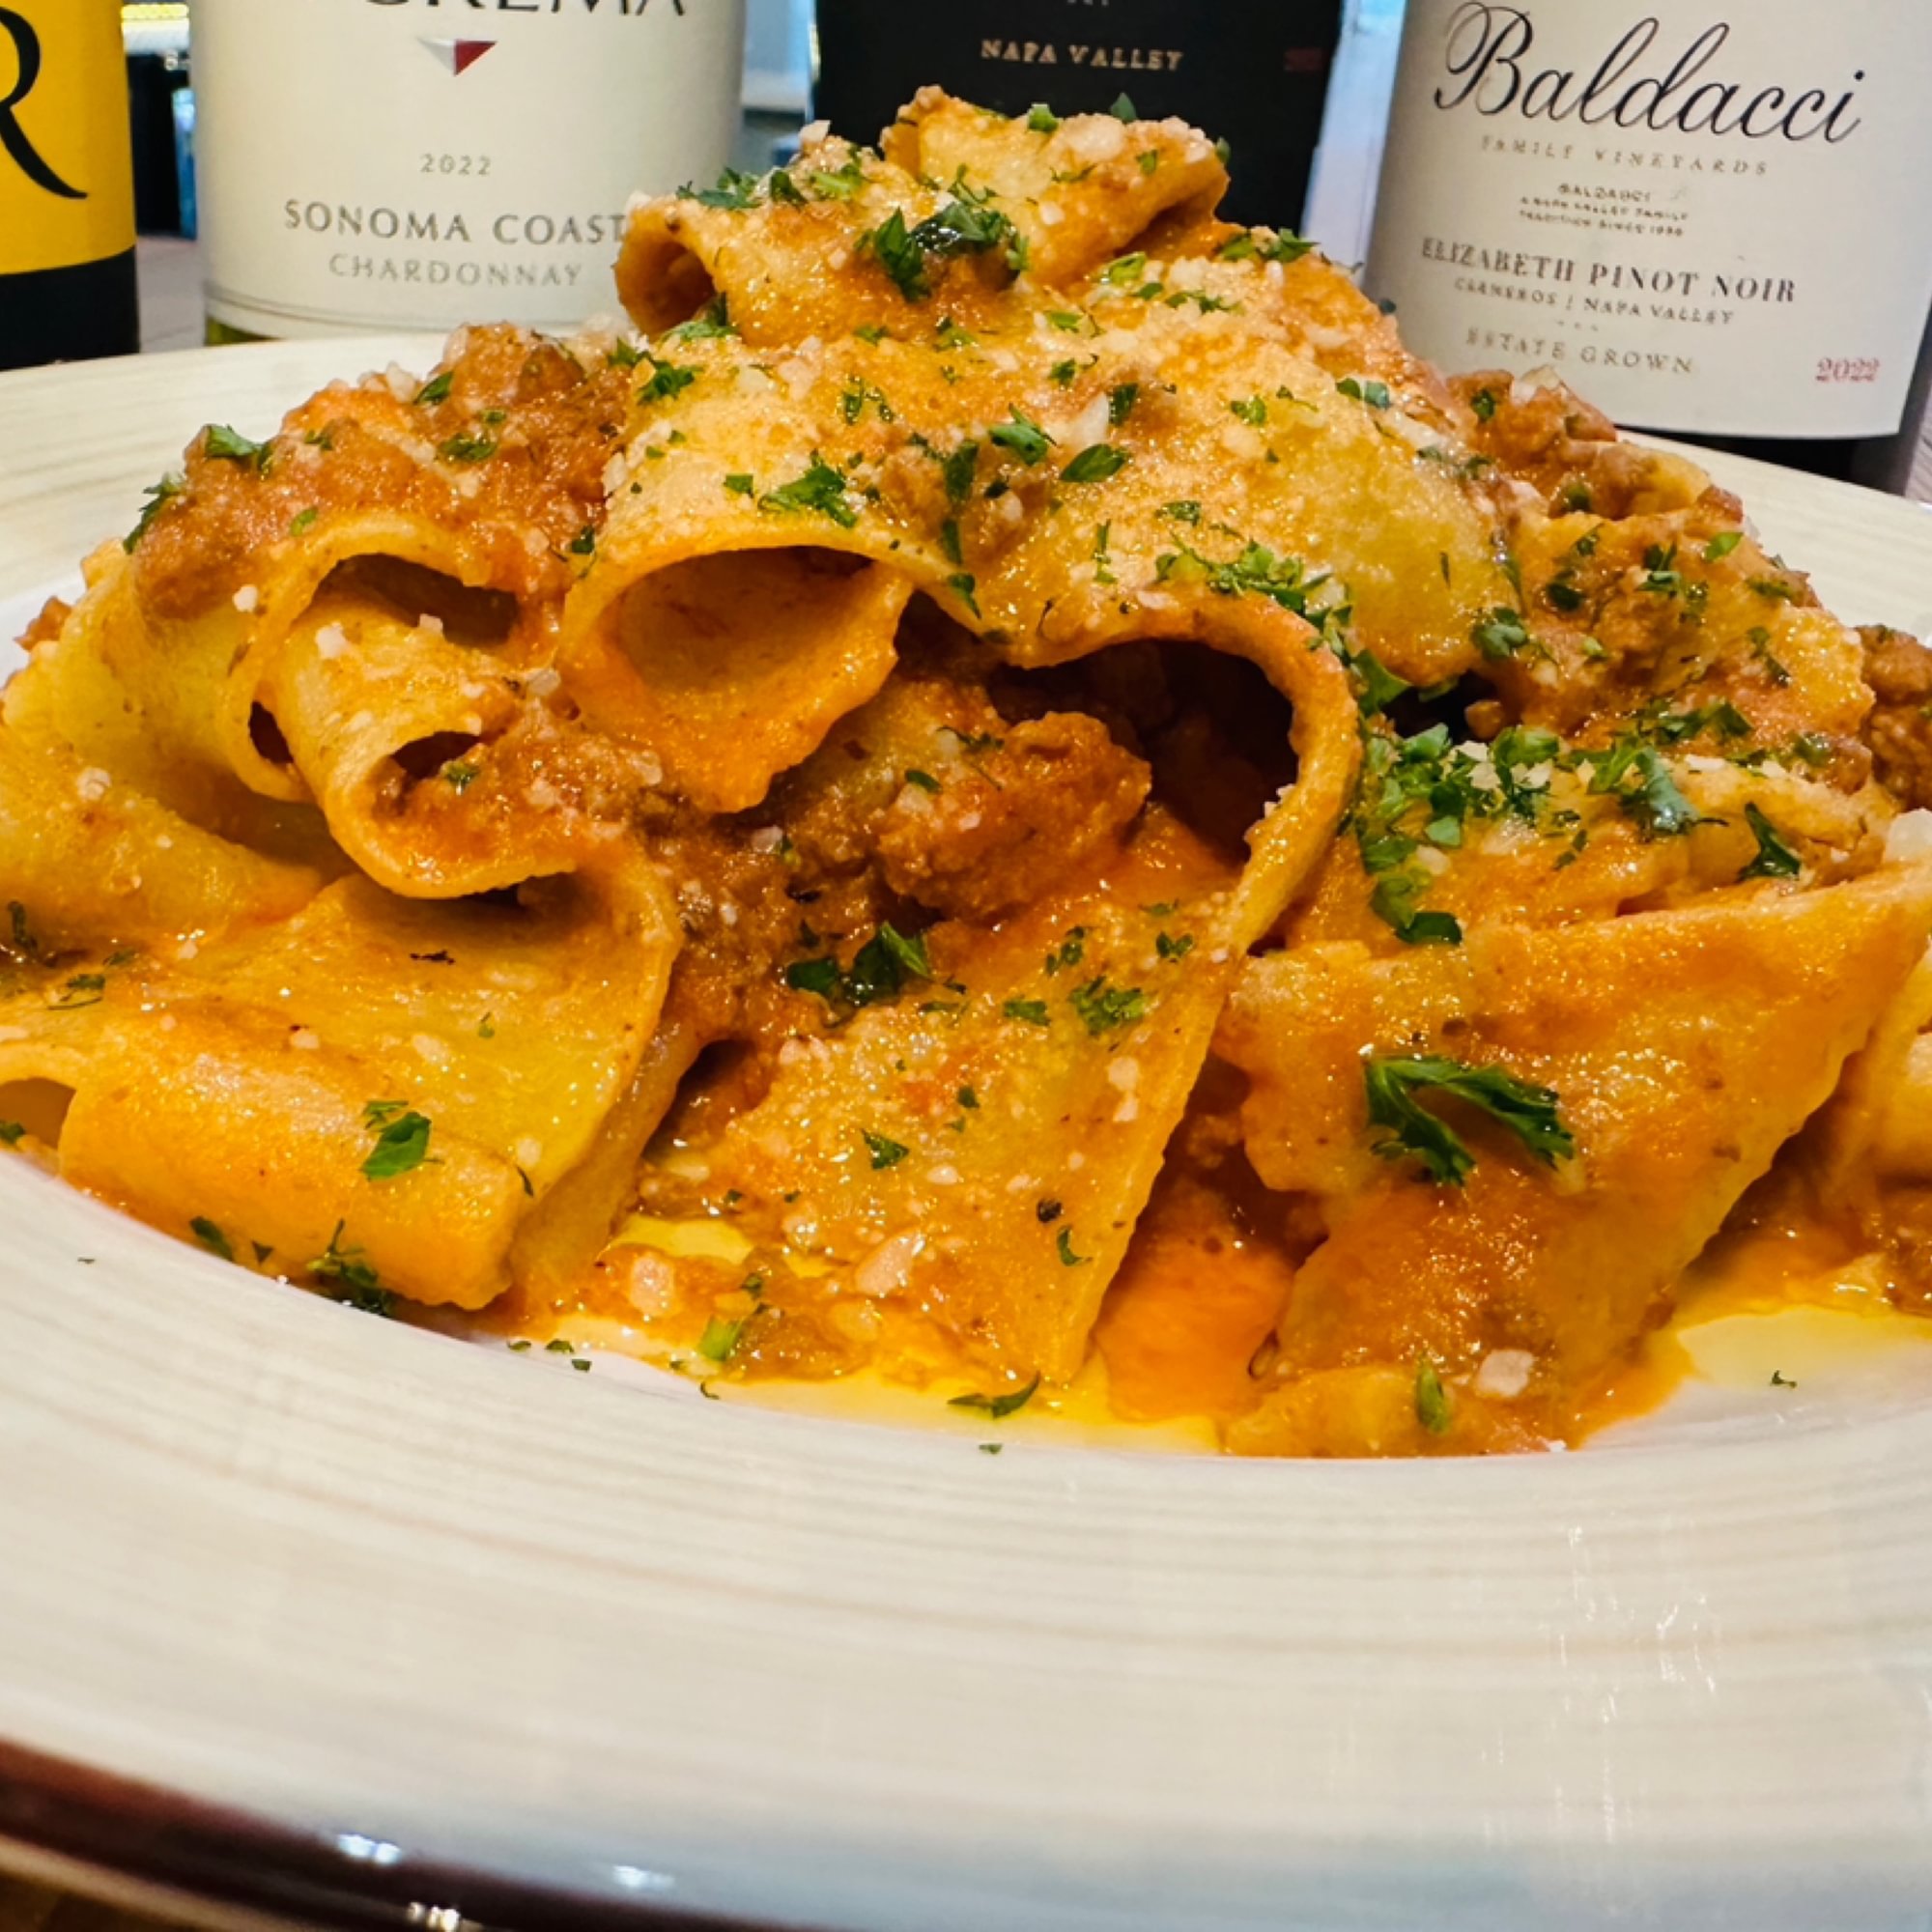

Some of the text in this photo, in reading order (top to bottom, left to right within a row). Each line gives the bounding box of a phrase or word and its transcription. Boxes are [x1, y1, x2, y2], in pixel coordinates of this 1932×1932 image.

[980, 39, 1183, 71] NAPA VALLEY
[1435, 1, 1865, 143] Baldacci
[420, 153, 492, 177] 2022
[1482, 134, 1768, 176] FAMILY VINEYARDS
[284, 198, 626, 245] SONOMA COAST
[328, 252, 582, 287] CHARDONNAY
[1421, 237, 1797, 303] ELIZABETH PINOT NOIR
[1583, 297, 1642, 318] NAPA
[1650, 304, 1735, 327] VALLEY
[1464, 326, 1694, 374] ESTATE GROWN
